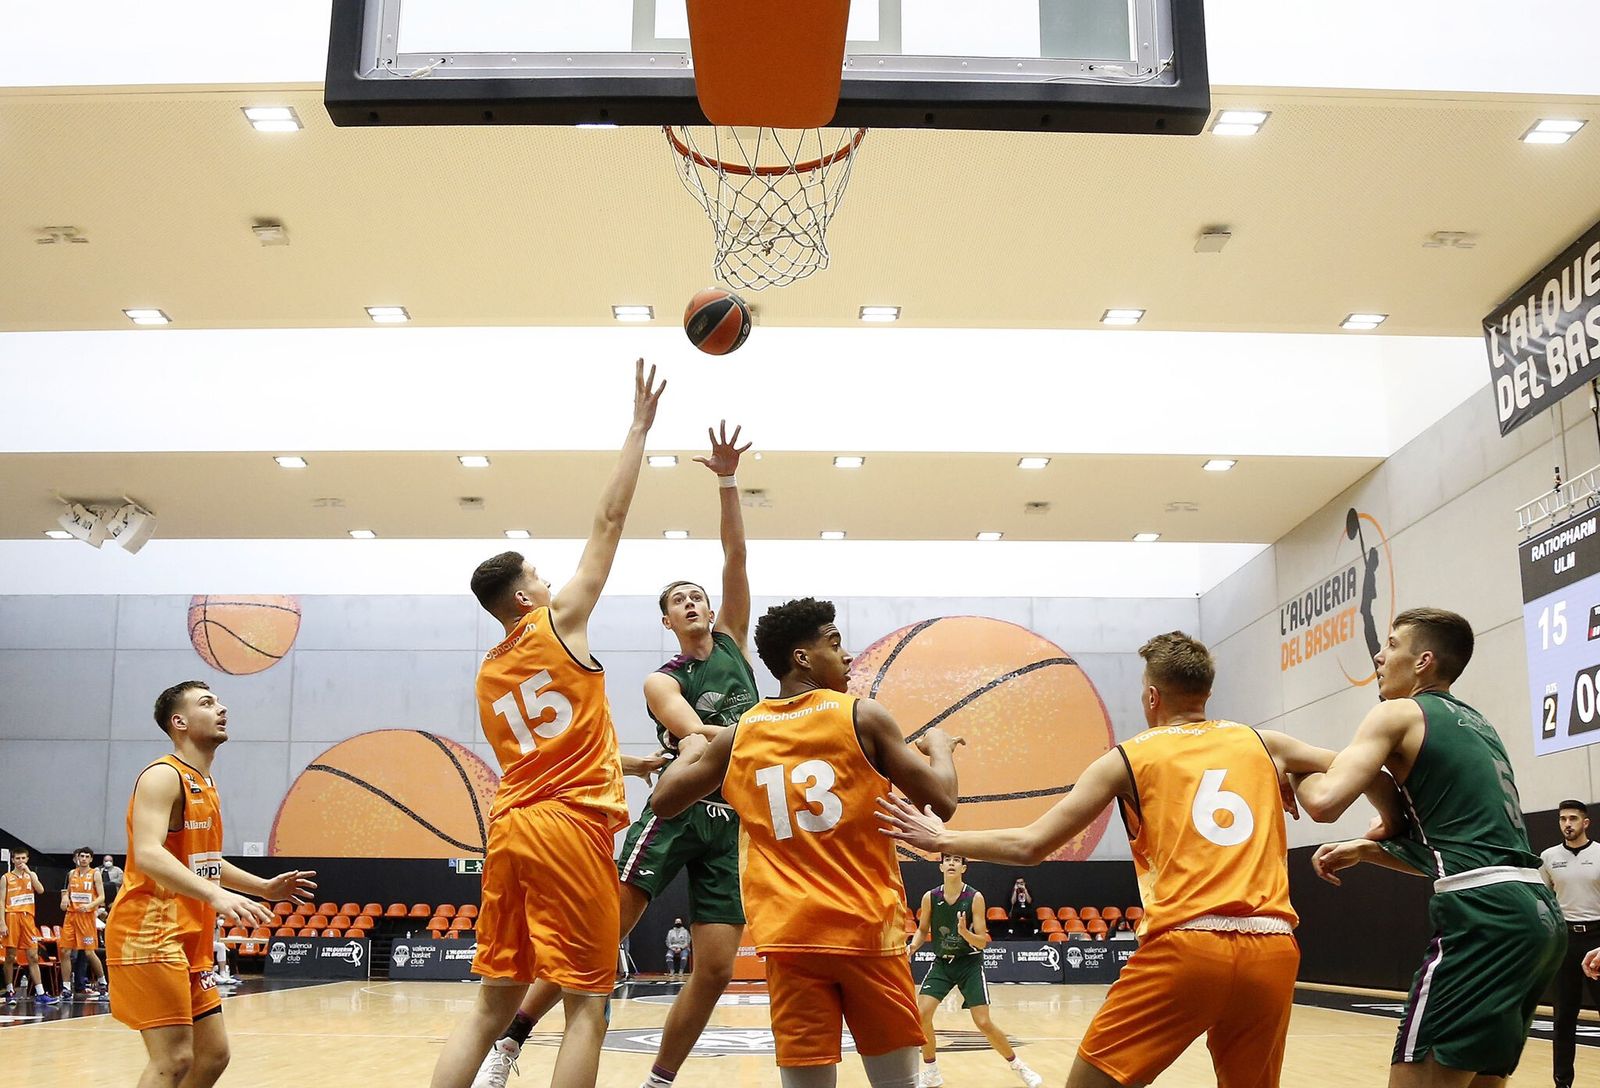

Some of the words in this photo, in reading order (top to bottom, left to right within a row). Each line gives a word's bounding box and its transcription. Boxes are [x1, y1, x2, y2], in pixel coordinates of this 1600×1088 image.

[1498, 355, 1544, 422] DEL
[1531, 517, 1596, 562] RATIOPHARM
[1554, 551, 1575, 574] ULM
[1281, 567, 1356, 636] L'ALQUERIA
[1538, 601, 1567, 650] 15
[1281, 636, 1303, 672] DEL
[1305, 607, 1356, 660] BASKET
[492, 669, 573, 754] 15
[745, 705, 813, 725] ratiopharm
[815, 700, 839, 712] ulm
[1544, 697, 1556, 731] 2
[756, 759, 843, 840] 13
[1192, 769, 1254, 847] 6
